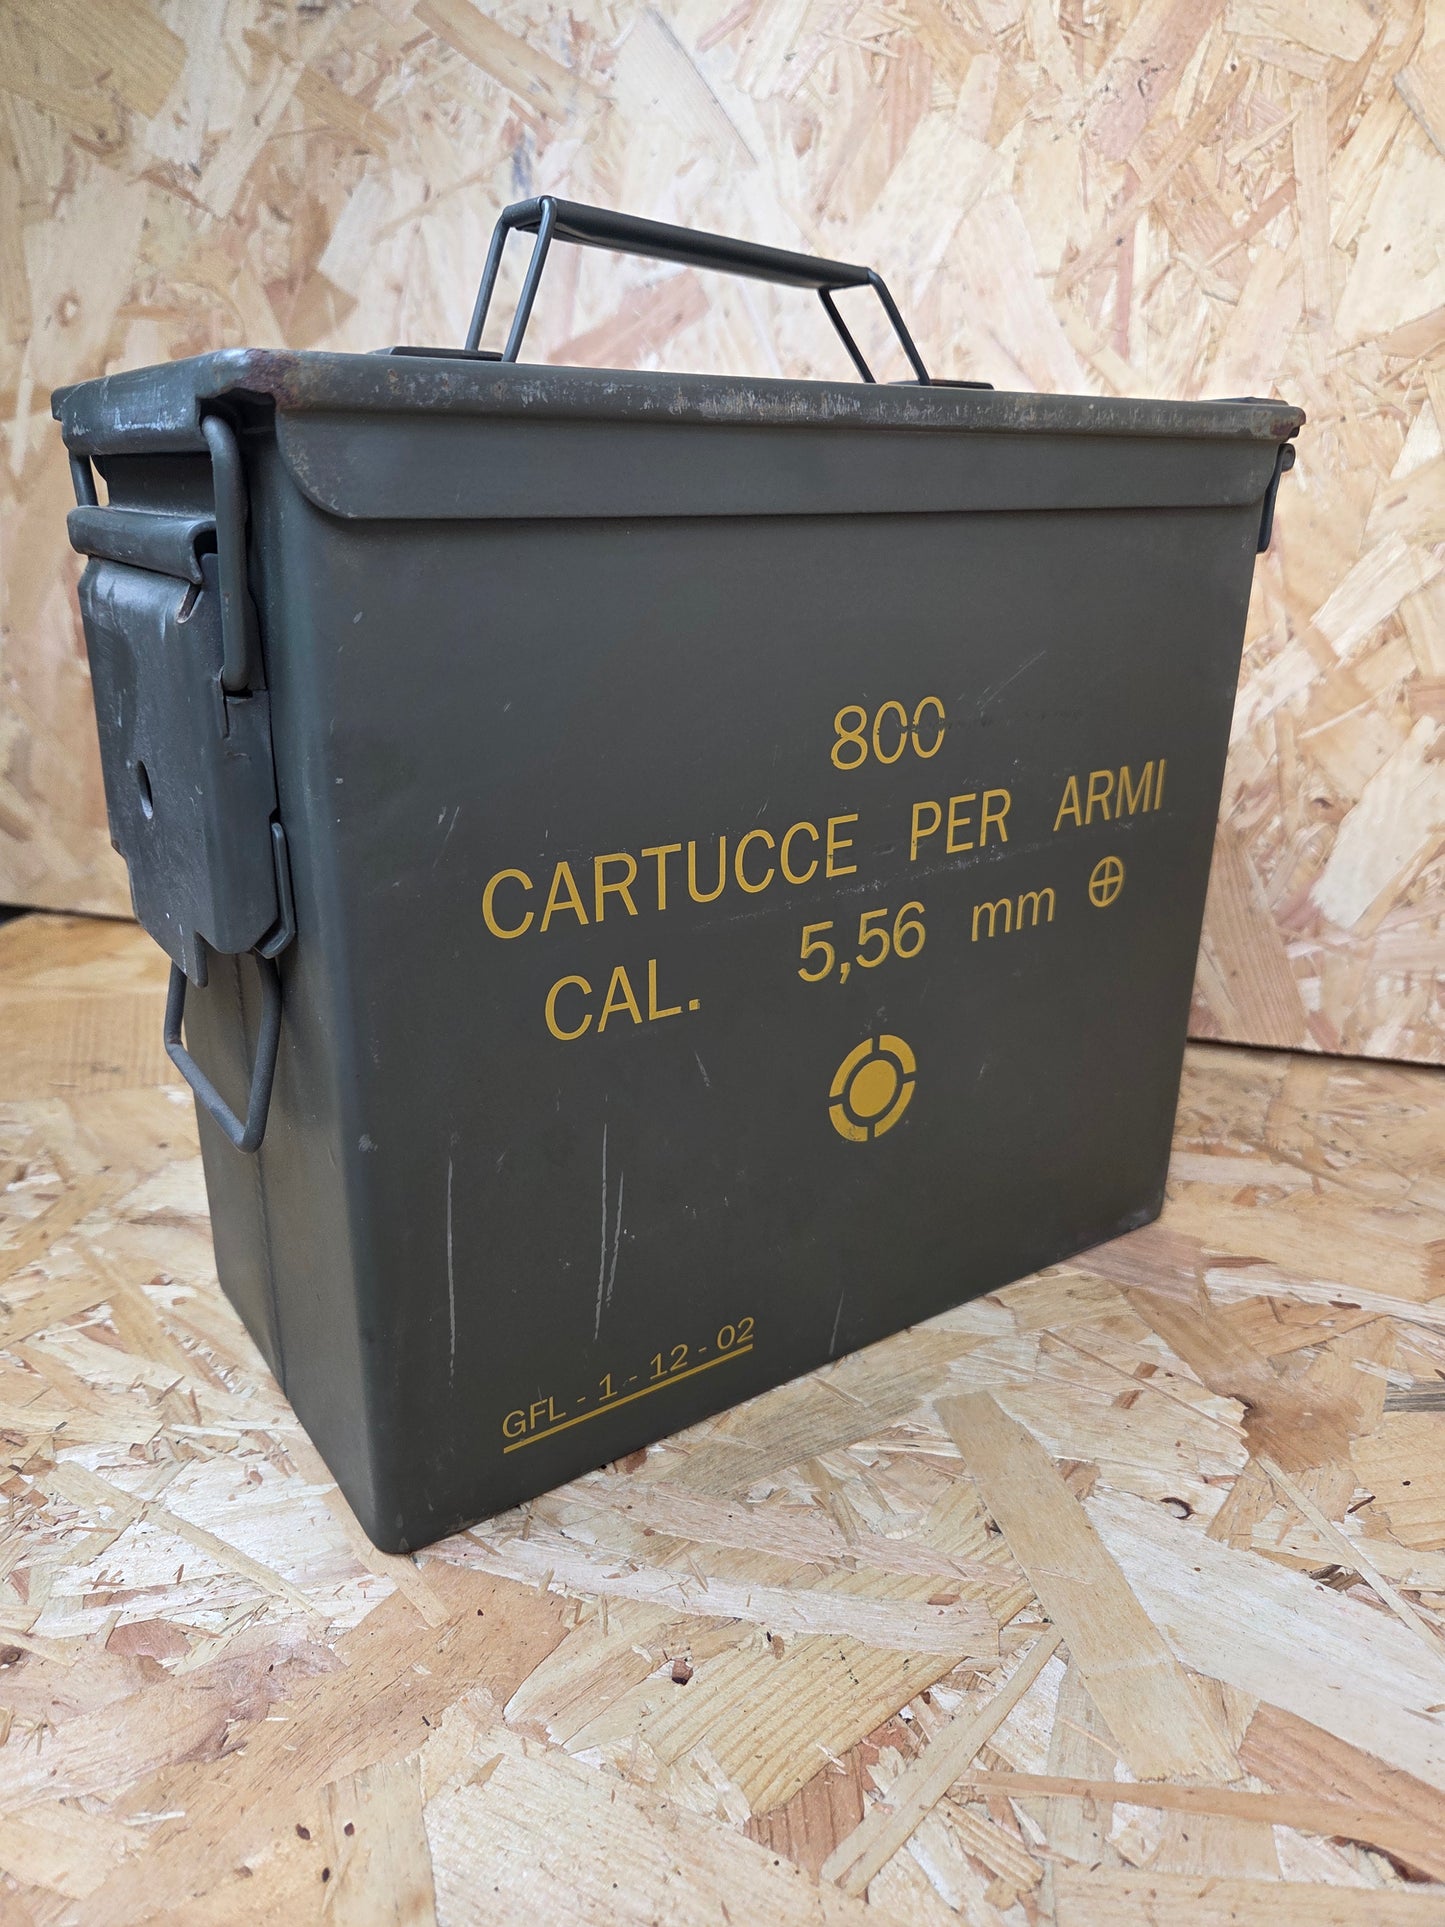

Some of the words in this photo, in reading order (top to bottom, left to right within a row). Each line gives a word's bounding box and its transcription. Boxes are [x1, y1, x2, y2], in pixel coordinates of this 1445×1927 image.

[829, 695, 947, 771] 800
[481, 812, 860, 940] CARTUCCE
[909, 788, 1012, 861] PER
[1053, 759, 1168, 832] ARMI
[544, 959, 701, 1041] CAL.
[798, 900, 927, 984] 5,56
[971, 887, 1057, 942] mm
[502, 1395, 567, 1439] GFL
